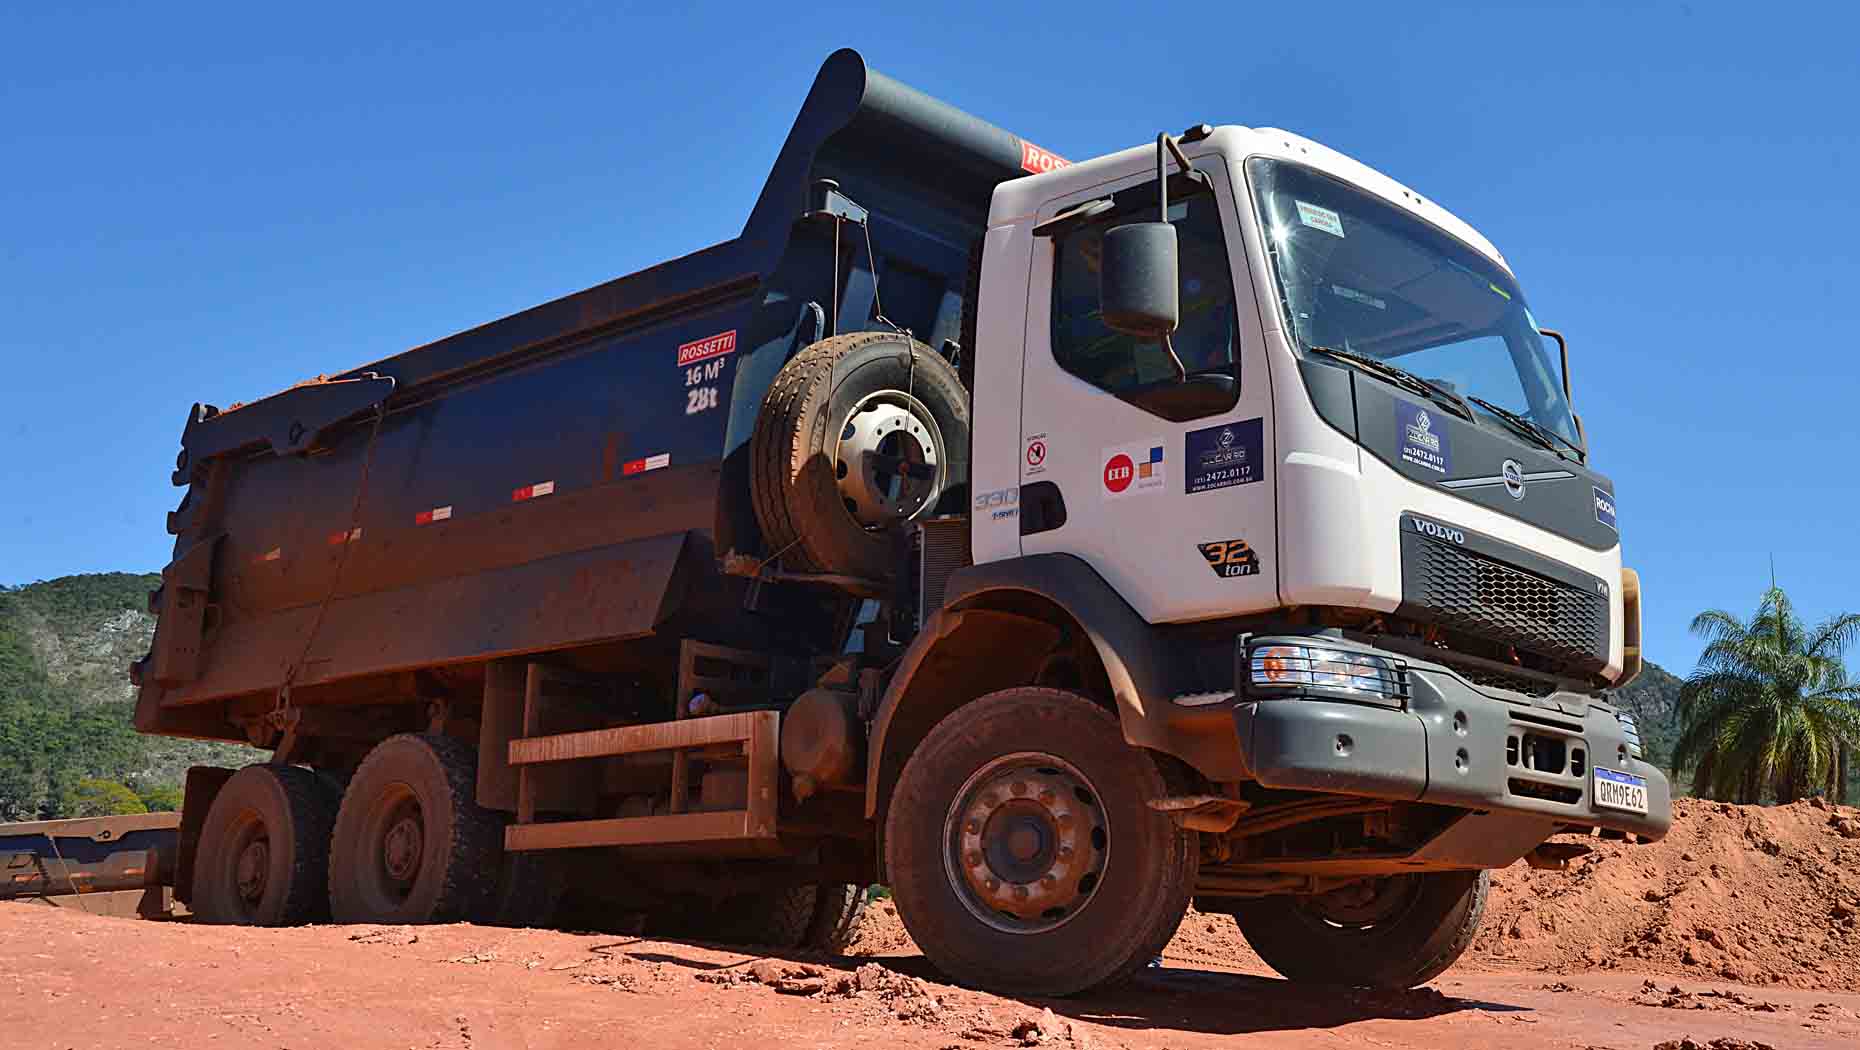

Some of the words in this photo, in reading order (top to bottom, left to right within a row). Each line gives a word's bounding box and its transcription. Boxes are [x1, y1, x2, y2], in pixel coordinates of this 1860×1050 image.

[680, 335, 733, 361] ROSSETTI
[685, 366, 702, 386] 16
[1412, 447, 1445, 465] 2472.0117
[1206, 465, 1251, 482] 2472.0117
[1412, 517, 1465, 545] VOLVO
[1206, 541, 1249, 565] 32
[1225, 564, 1250, 576] ton
[1600, 781, 1644, 809] QRM9E62
